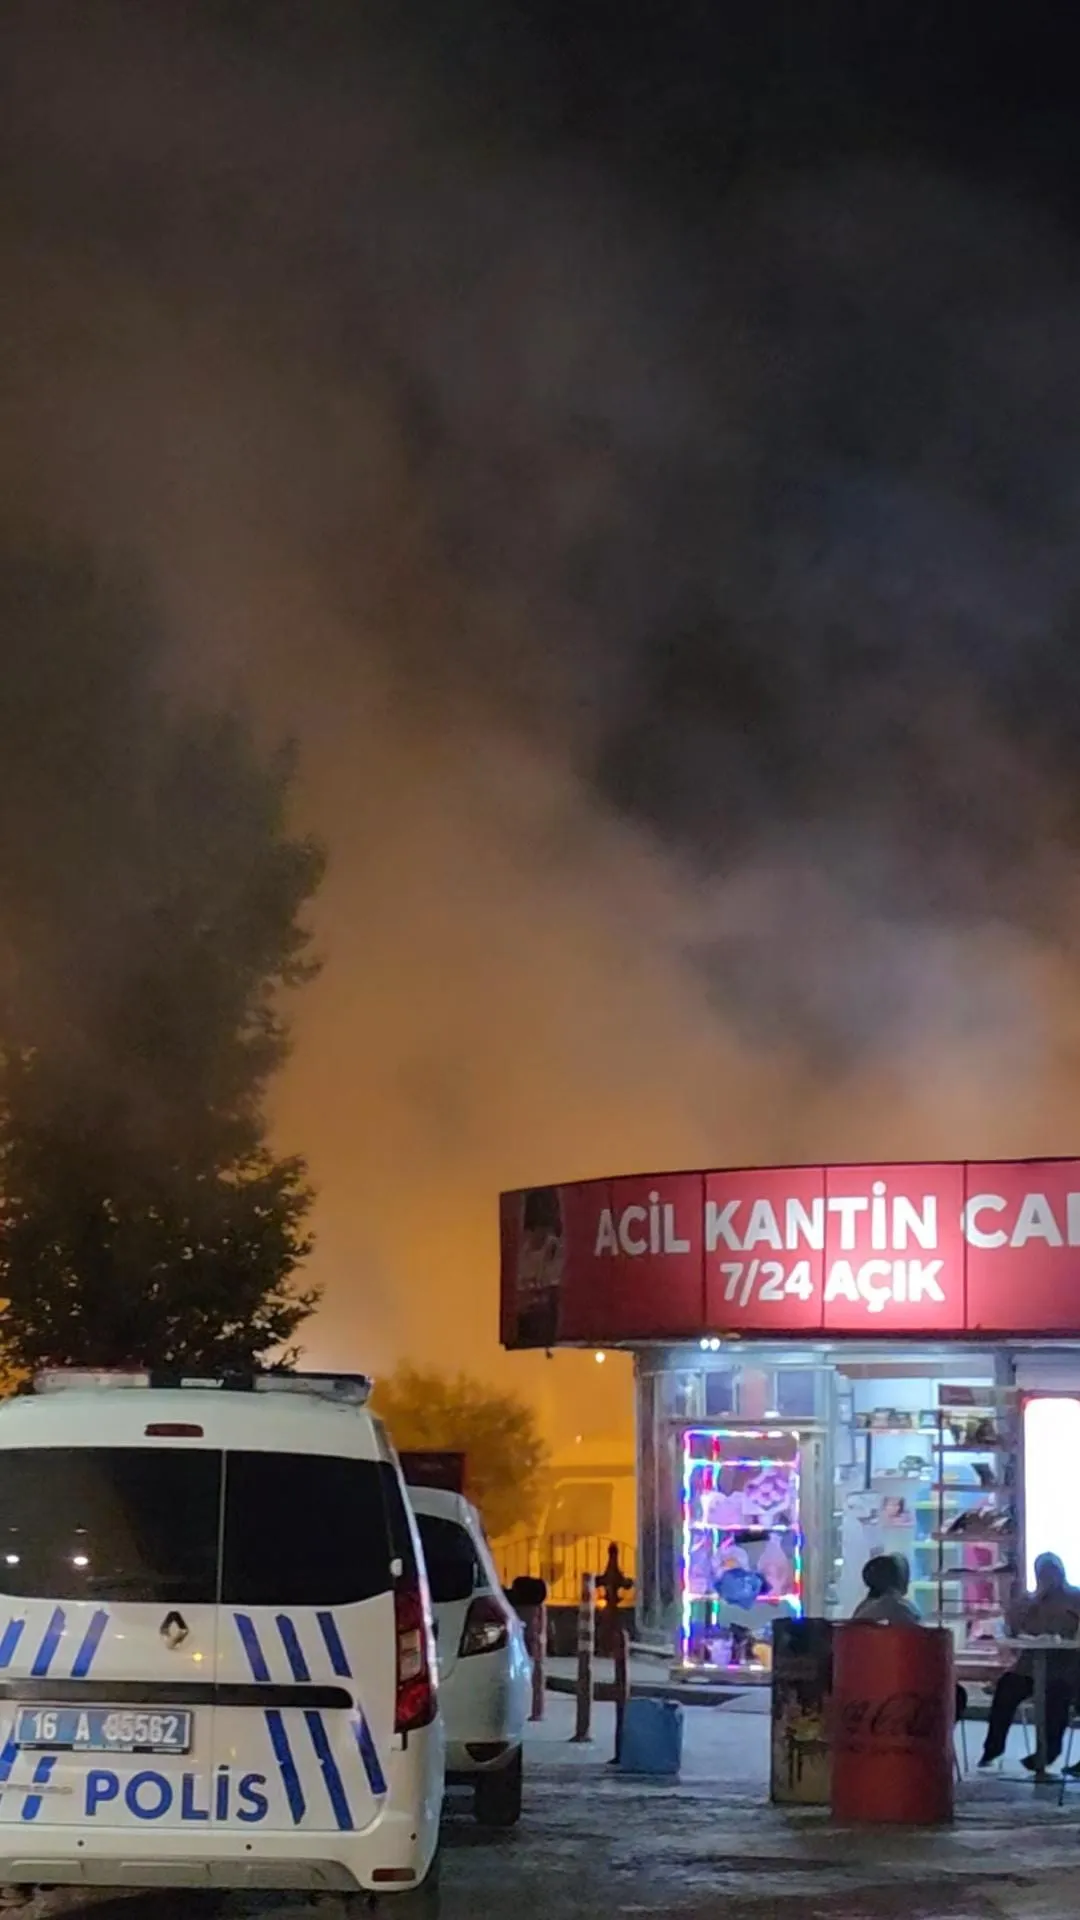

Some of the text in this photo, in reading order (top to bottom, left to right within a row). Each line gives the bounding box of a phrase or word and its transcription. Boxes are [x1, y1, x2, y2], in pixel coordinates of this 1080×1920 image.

[594, 1190, 691, 1256] ACİL
[705, 1181, 938, 1251] KANTİN
[720, 1259, 946, 1313] 7/24 AÇIK
[32, 1712, 58, 1740] 16
[75, 1712, 91, 1741] A
[85, 1764, 268, 1822] POLİS
